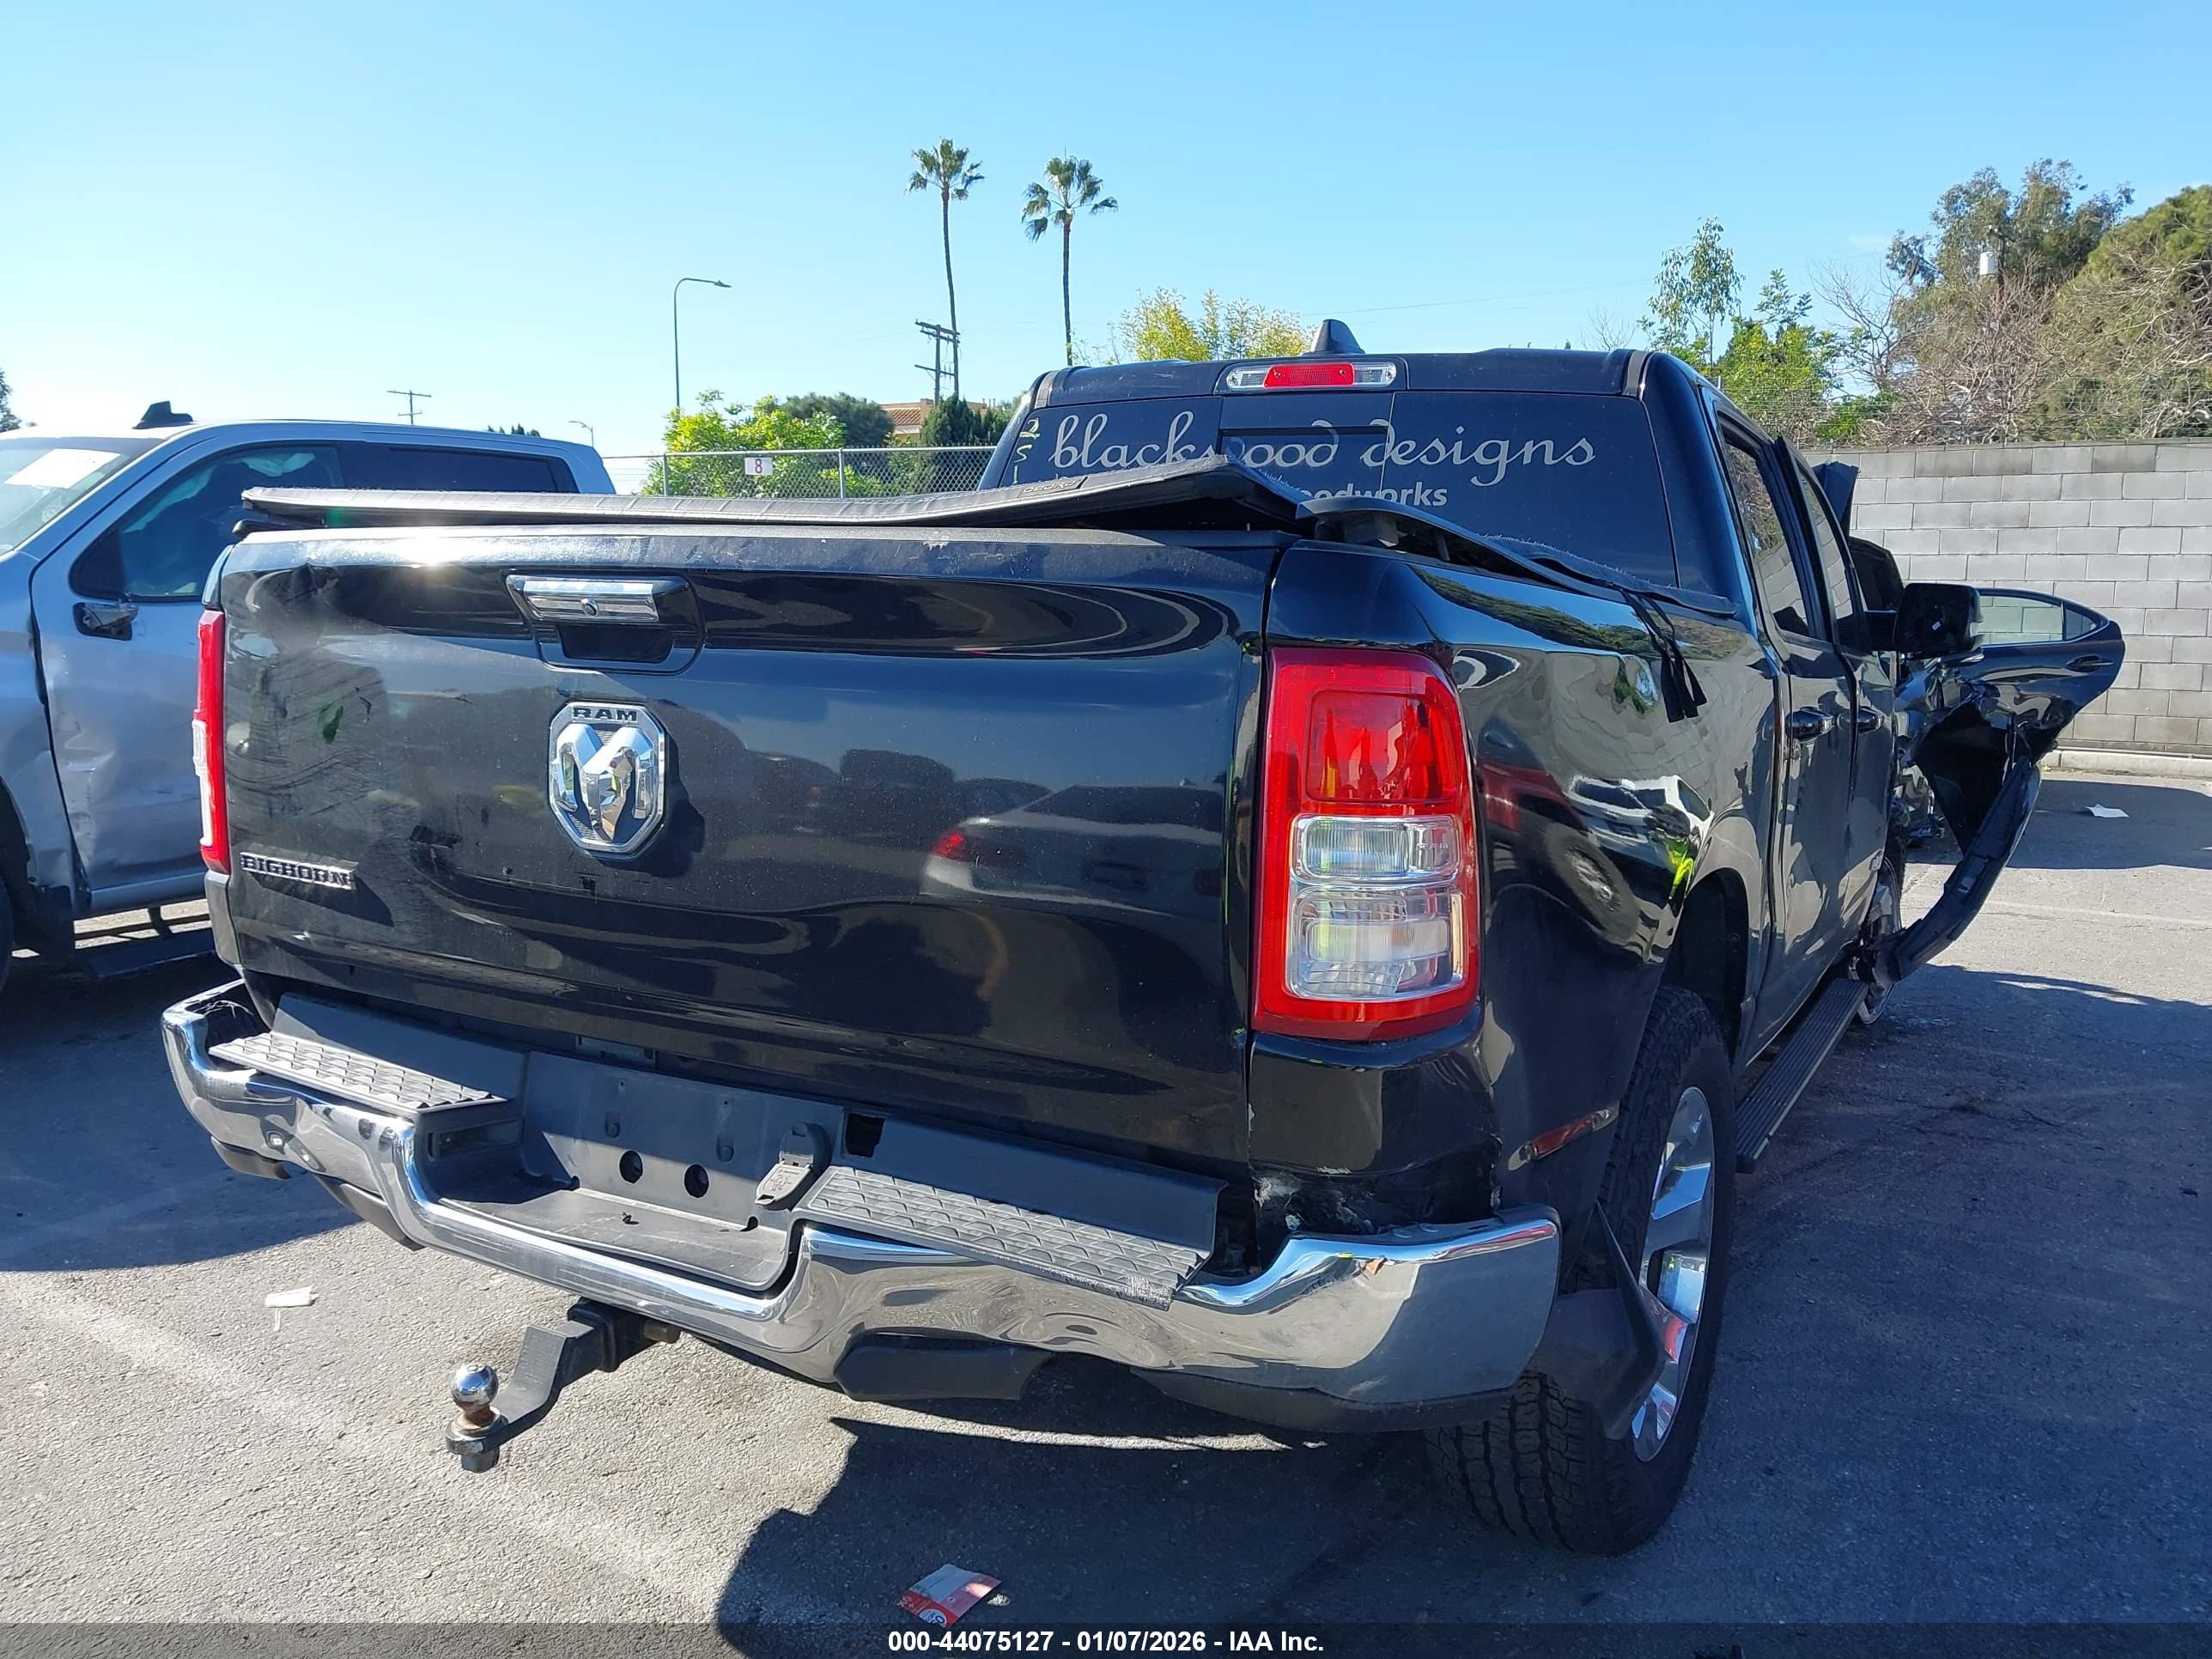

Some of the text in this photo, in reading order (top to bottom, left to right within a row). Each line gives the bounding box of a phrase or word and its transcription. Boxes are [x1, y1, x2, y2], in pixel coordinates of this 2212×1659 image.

[1360, 418, 1596, 487] designs
[755, 459, 763, 474] 8
[1299, 481, 1449, 507] dorks
[572, 707, 638, 722] RAM
[239, 852, 357, 890] BIGHORN
